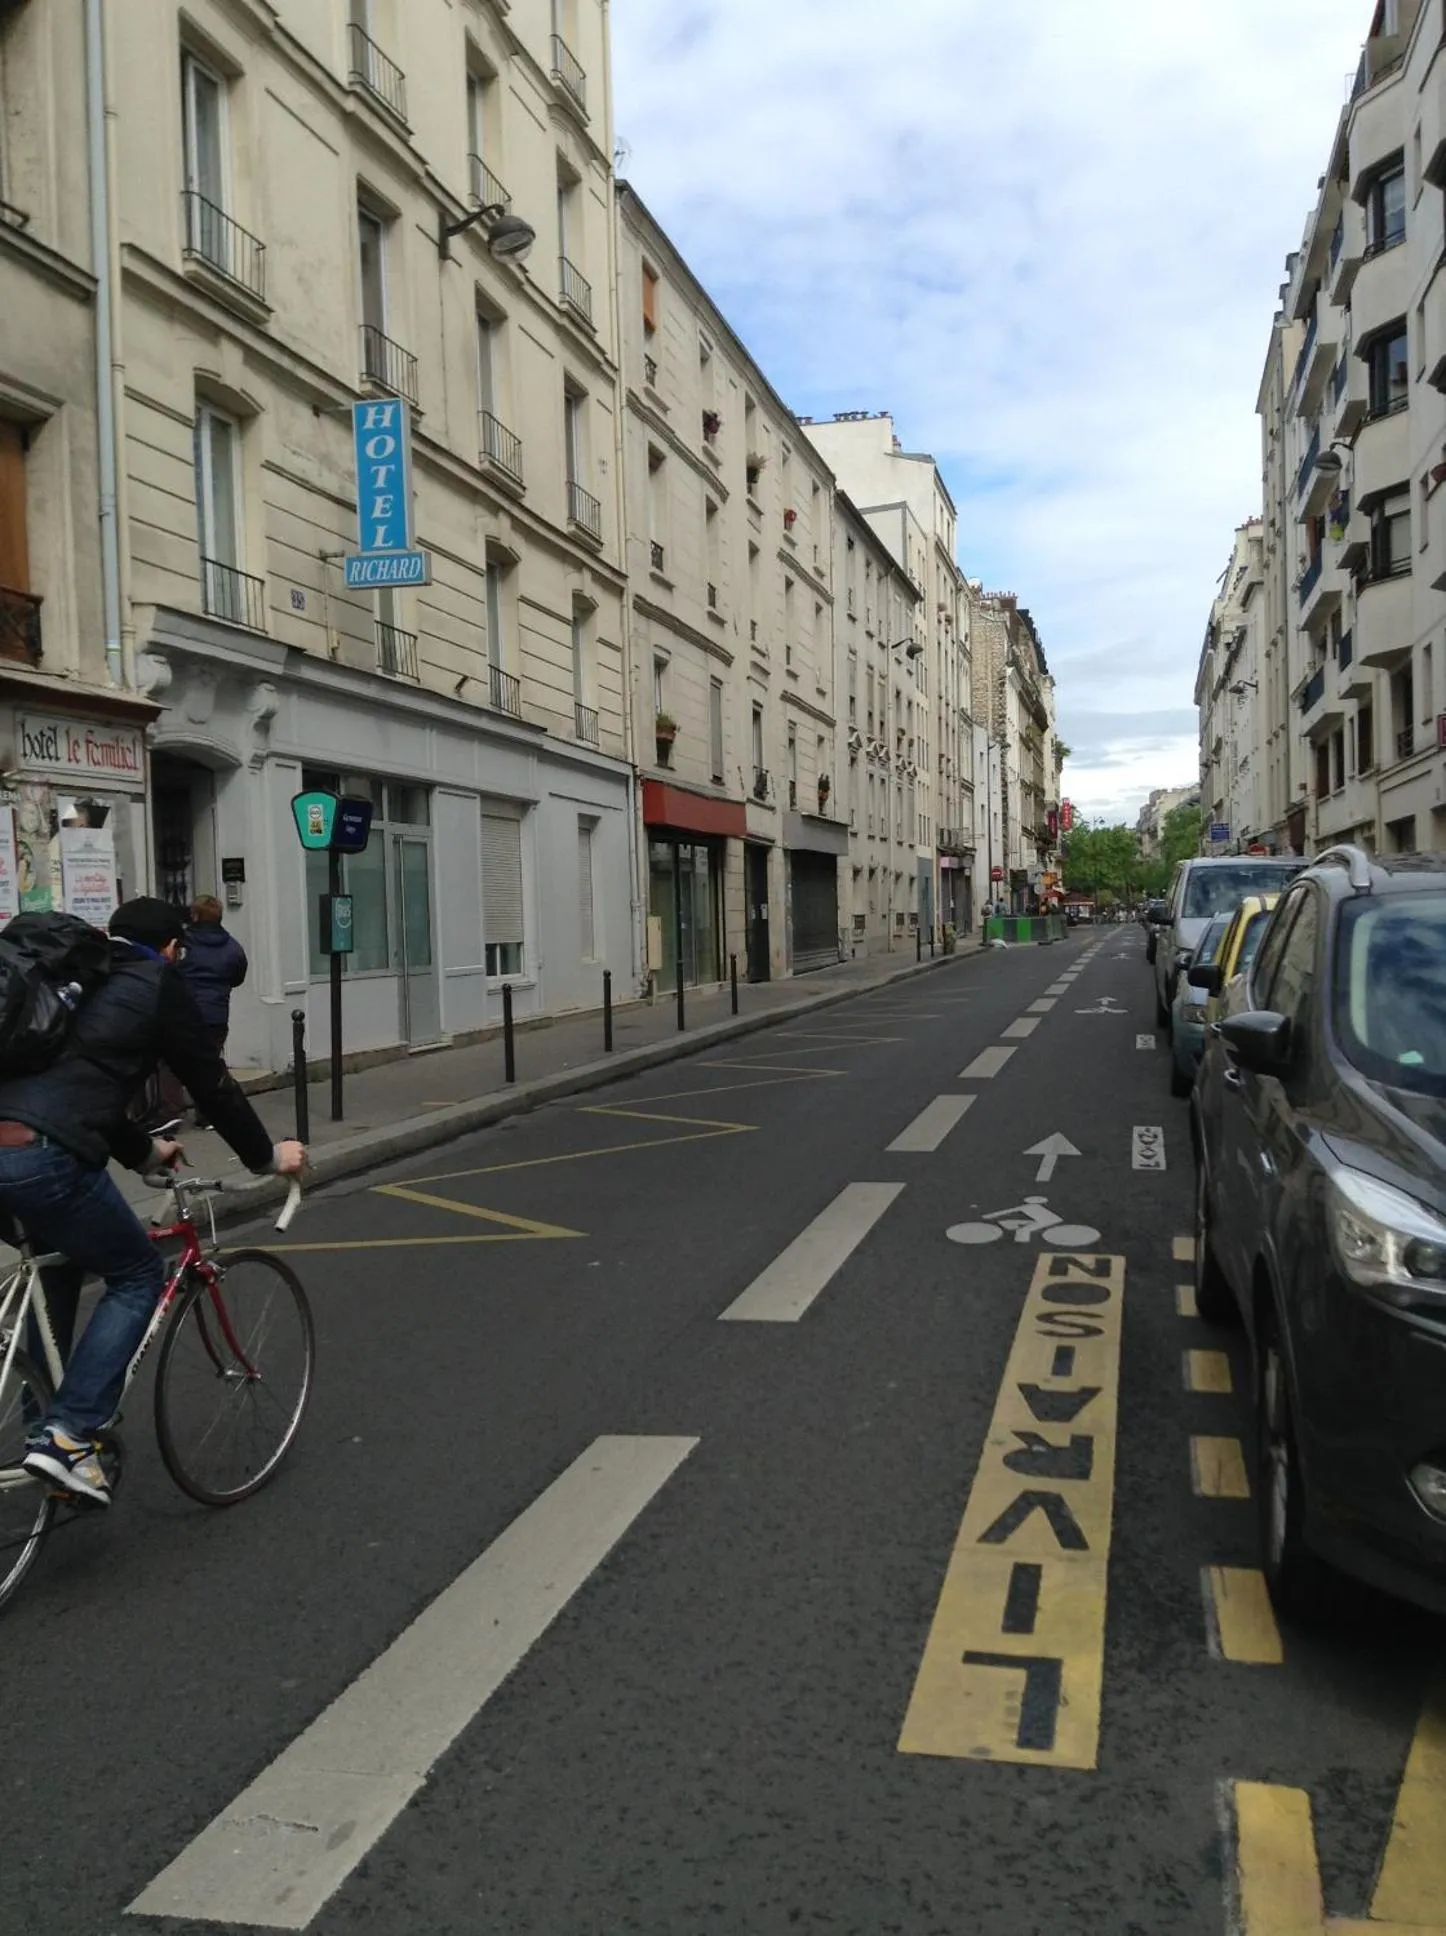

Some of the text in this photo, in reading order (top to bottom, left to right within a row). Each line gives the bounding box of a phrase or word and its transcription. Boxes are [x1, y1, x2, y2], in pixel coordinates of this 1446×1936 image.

[363, 403, 395, 548] HOTEL
[349, 557, 421, 583] RICHARD
[65, 725, 81, 764] le
[962, 1255, 1112, 1751] LIVRAISON
